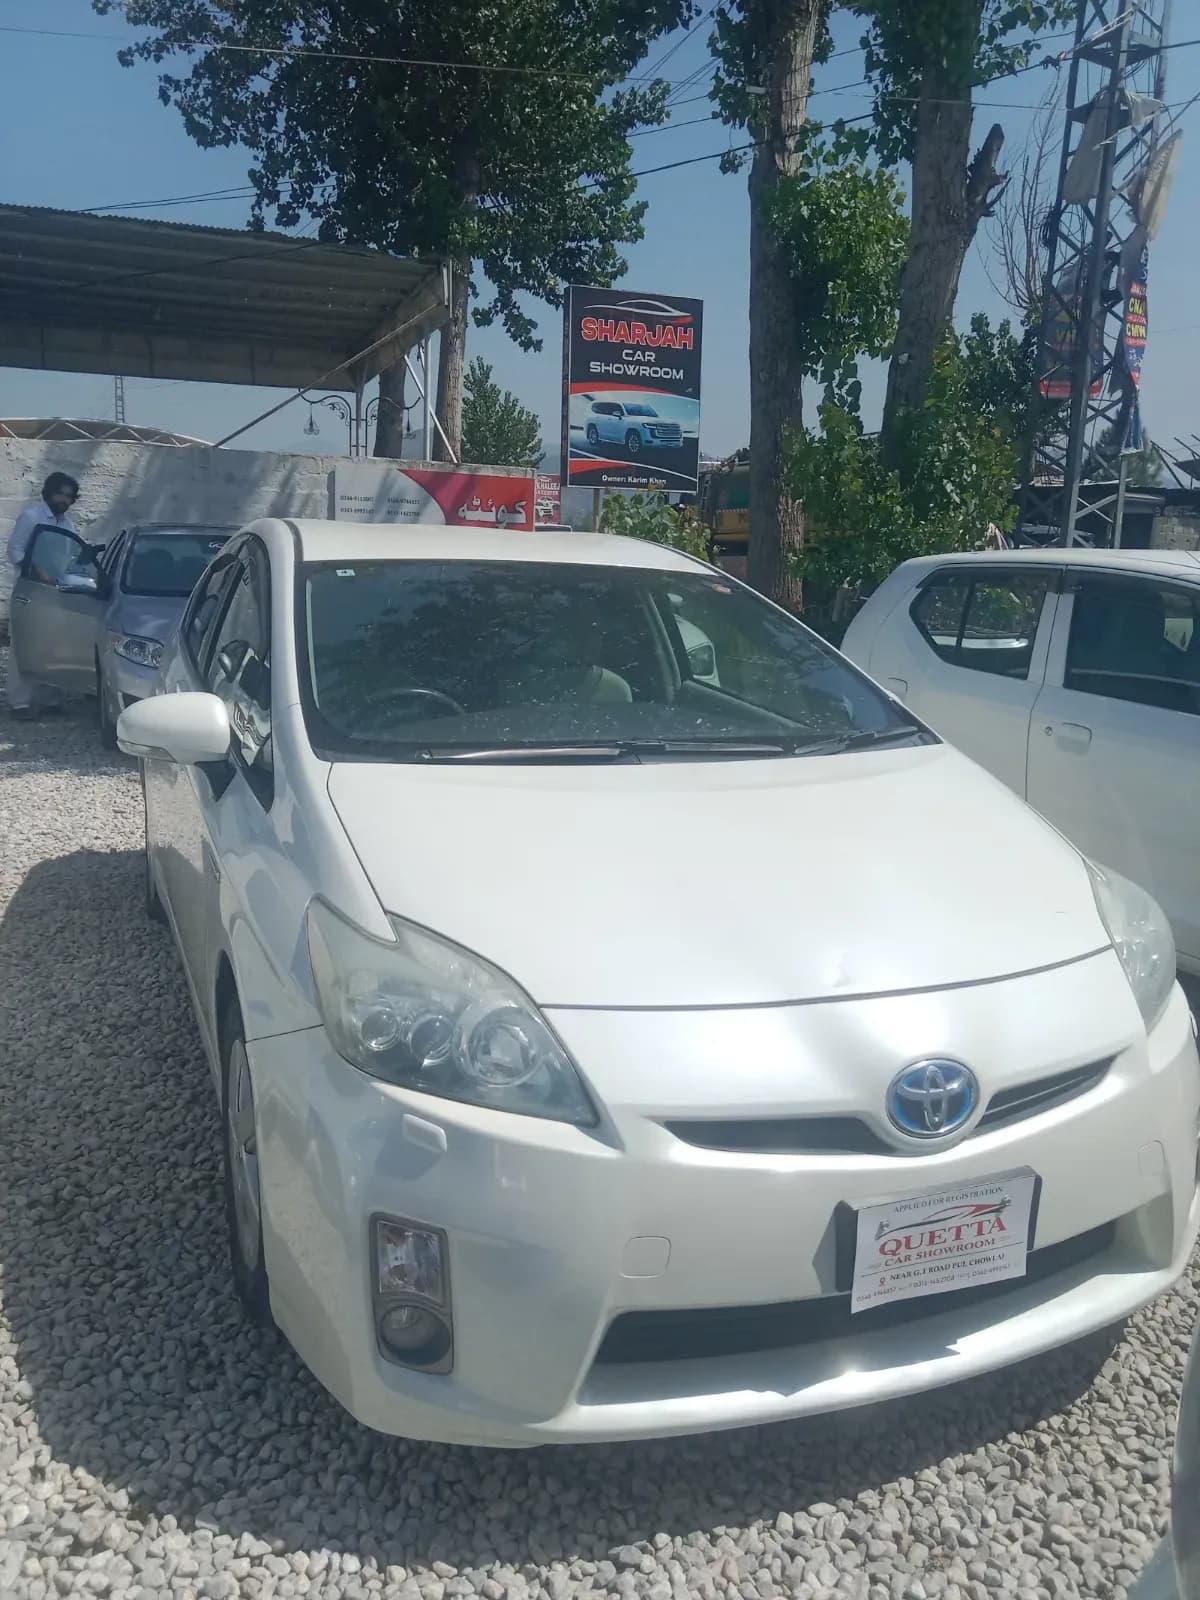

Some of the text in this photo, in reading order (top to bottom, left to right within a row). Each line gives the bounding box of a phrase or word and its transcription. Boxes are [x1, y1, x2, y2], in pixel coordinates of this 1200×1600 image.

[581, 316, 694, 349] SHARJAH
[622, 350, 656, 363] CAR
[589, 361, 684, 381] SHOWROOM
[628, 476, 648, 484] Karim
[894, 1186, 1004, 1214] APPLIED FOR REGISTRATION
[879, 1216, 1007, 1257] QUETTA
[884, 1238, 996, 1267] CAR SHOWROOM
[890, 1271, 912, 1281] NEAR
[928, 1263, 951, 1273] ROAD
